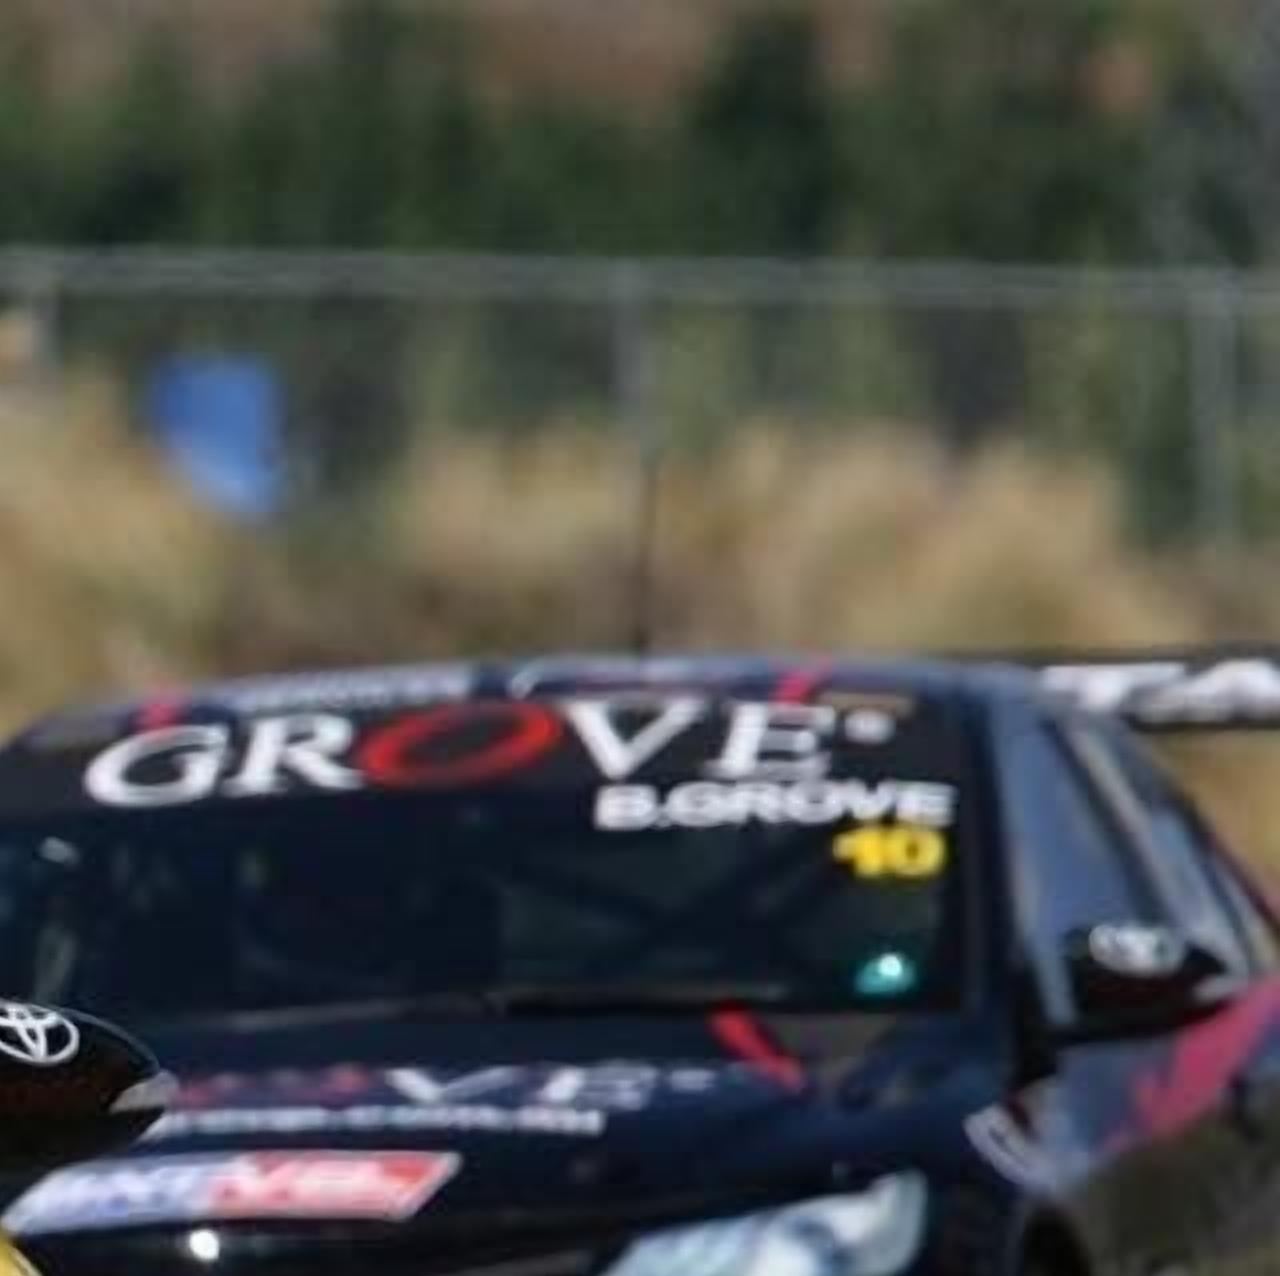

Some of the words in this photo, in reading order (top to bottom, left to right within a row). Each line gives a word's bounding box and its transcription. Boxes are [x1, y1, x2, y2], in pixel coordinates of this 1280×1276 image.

[83, 697, 834, 807] GROVE
[594, 778, 958, 831] B.GROVE
[833, 825, 947, 879] 10
